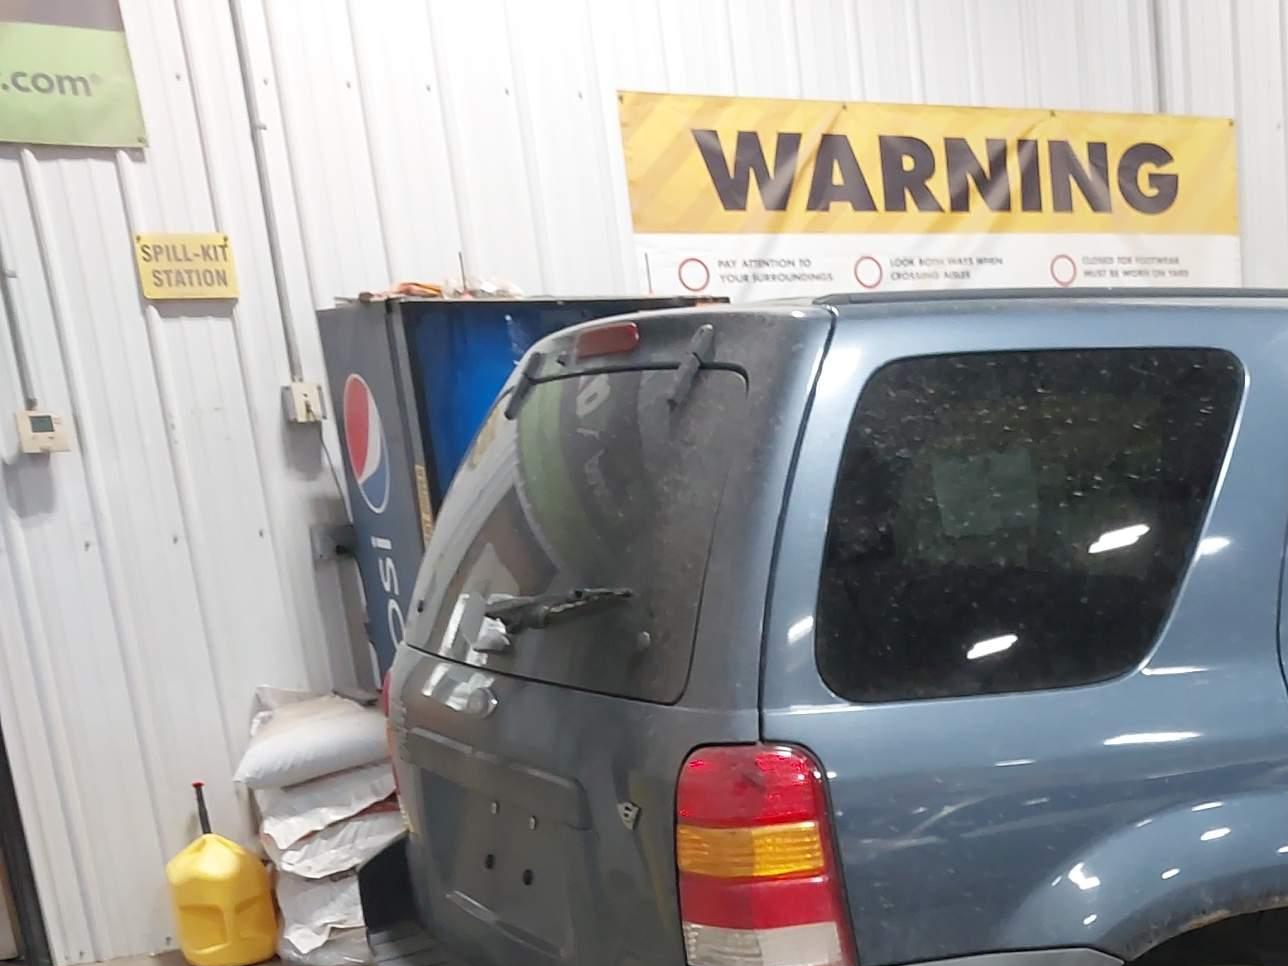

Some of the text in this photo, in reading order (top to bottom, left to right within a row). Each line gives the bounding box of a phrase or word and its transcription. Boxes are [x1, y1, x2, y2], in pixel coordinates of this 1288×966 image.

[691, 128, 1179, 216] WARNING
[140, 243, 228, 263] SPILL-KIT
[742, 258, 796, 268] ATTENTION
[152, 268, 228, 288] STATION
[720, 272, 834, 283] YOUR SURROUNDINGS
[890, 271, 940, 281] CROSSING
